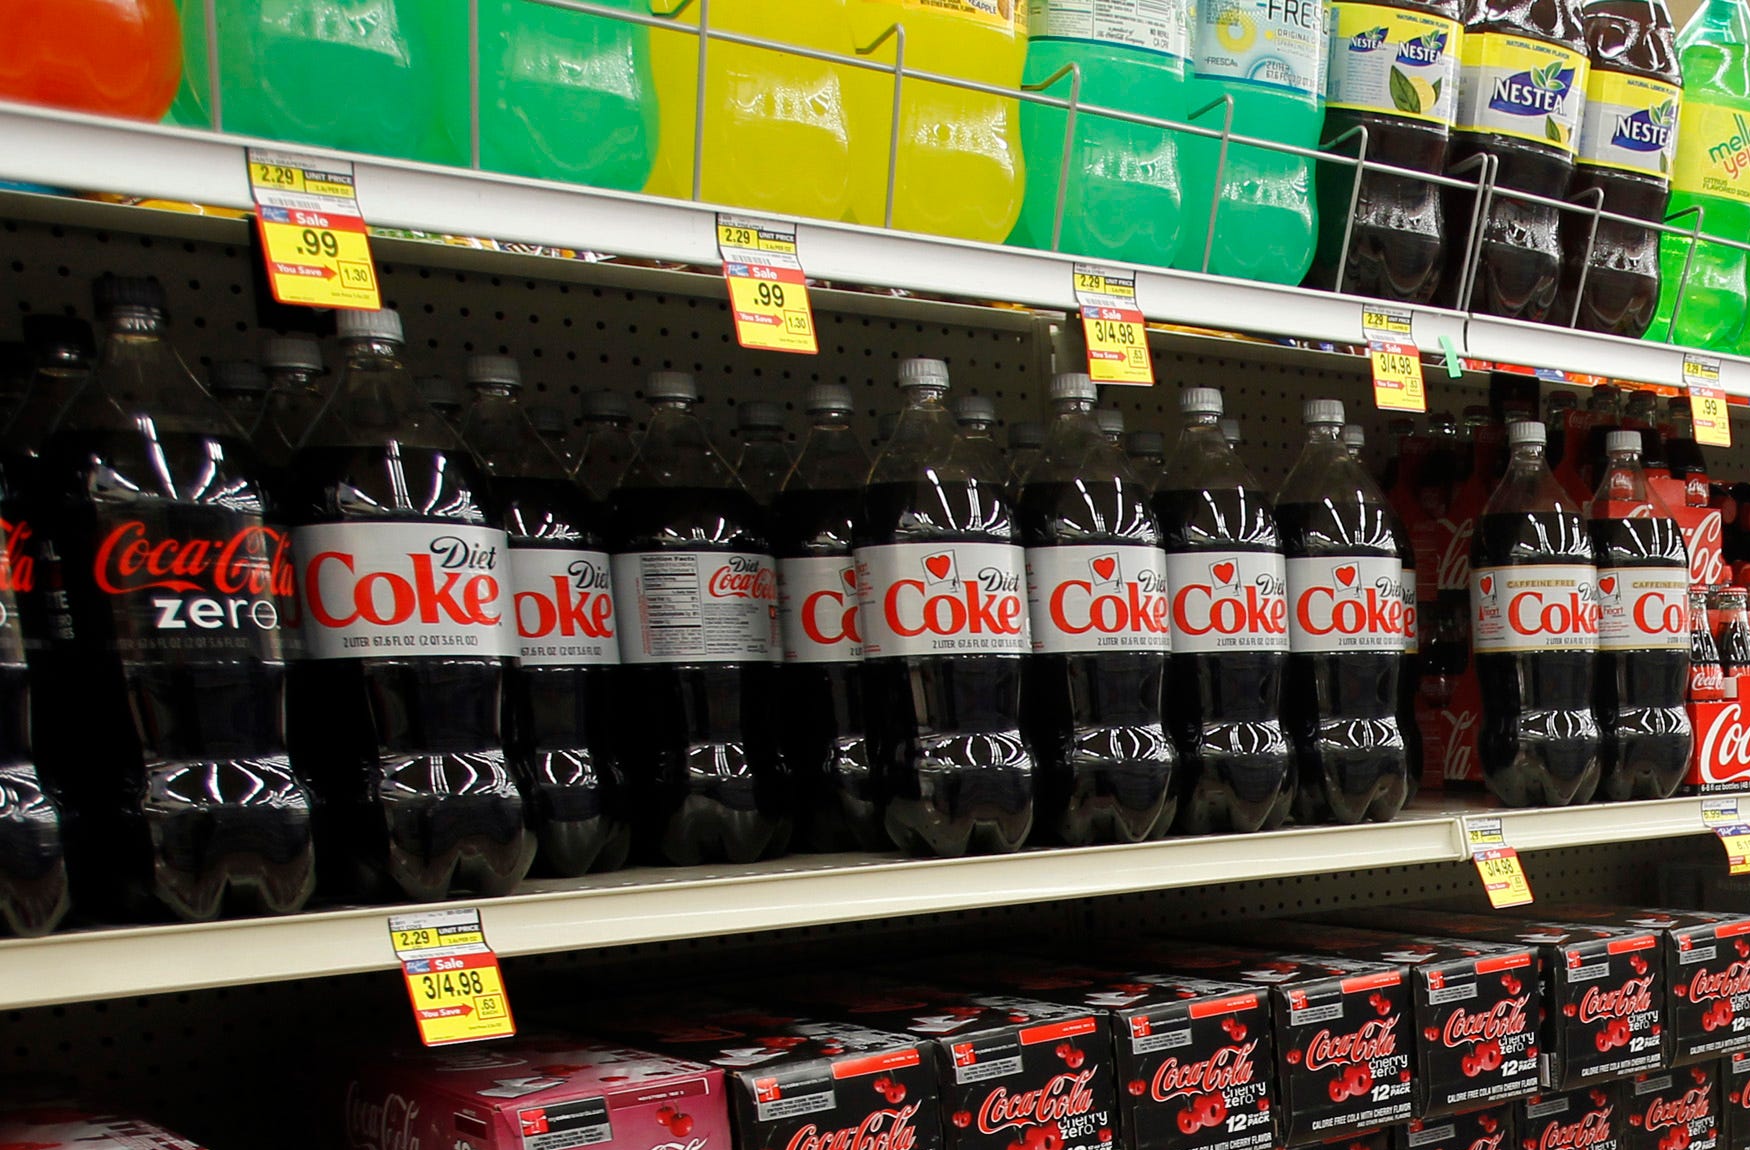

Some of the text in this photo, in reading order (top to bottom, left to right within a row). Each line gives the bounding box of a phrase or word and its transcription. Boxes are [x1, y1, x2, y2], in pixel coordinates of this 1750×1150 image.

[1351, 36, 1383, 50] NESTEA
[1399, 41, 1443, 65] NESTEA
[1493, 77, 1564, 115] NESTEA
[260, 165, 294, 185] 2.29
[305, 171, 353, 184] UNIT PRICE
[1703, 176, 1728, 187] CITRUS
[295, 212, 329, 227] Sale
[296, 229, 338, 257] .99
[725, 228, 750, 244] 2.29
[277, 263, 322, 276] You Save
[343, 269, 368, 282] 1.30
[752, 267, 778, 280] Sale
[1080, 274, 1100, 288] 2.29
[753, 282, 785, 308] .99
[788, 317, 807, 329] 1.30
[1102, 310, 1122, 320] Sale
[1095, 319, 1135, 345] 3/4.98
[1380, 353, 1412, 375] 3/4.98
[1702, 398, 1718, 416] .99
[95, 521, 298, 598] Coca-Cola
[430, 535, 498, 570] Diet
[641, 555, 695, 563] Nutrition Facts
[978, 567, 1021, 592] Diet
[1507, 580, 1576, 589] CAFFEINE FREE
[305, 551, 501, 629] Coke
[156, 598, 280, 631] zero
[514, 575, 613, 639] oke
[884, 579, 1022, 636] Coke
[1049, 579, 1169, 635] Coke
[1173, 583, 1288, 636] Coke
[1508, 591, 1599, 636] Coke
[349, 637, 370, 647] LITER
[373, 636, 392, 647] 67.6
[393, 636, 401, 647] FL
[403, 636, 415, 647] OZ
[400, 930, 430, 946] 2.29
[439, 924, 480, 935] UNIT PRICE
[434, 958, 464, 970] Sale
[422, 971, 484, 1000] 3/4.98
[421, 1008, 461, 1018] You Save
[481, 998, 496, 1010] .63
[1444, 991, 1531, 1050] Coca-Cola
[977, 1064, 1097, 1136] Coca-Cola
